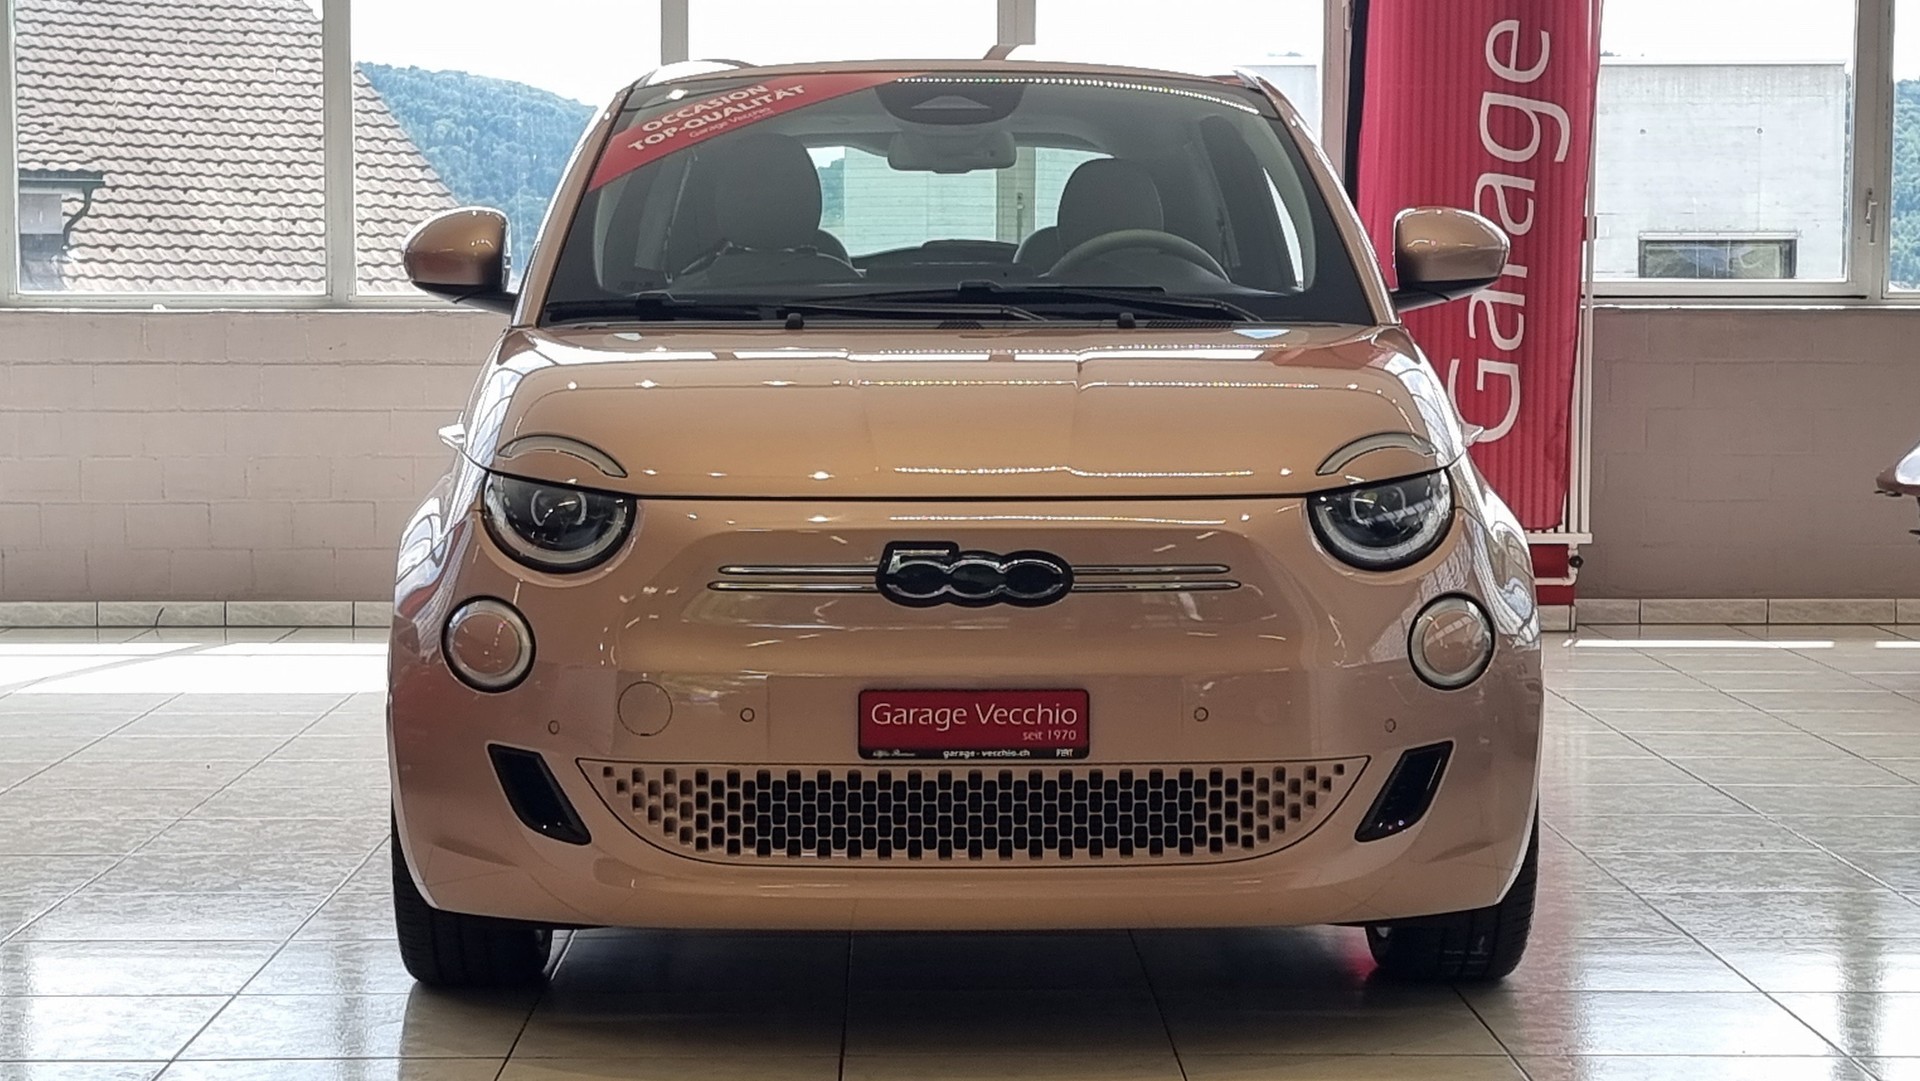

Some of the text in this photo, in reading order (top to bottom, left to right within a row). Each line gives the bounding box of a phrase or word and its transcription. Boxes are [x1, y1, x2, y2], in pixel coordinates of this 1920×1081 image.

[628, 84, 806, 151] TOP-QUALITÄT
[642, 84, 769, 132] OCCASION
[689, 121, 728, 138] Garage
[1447, 19, 1571, 444] Gaage
[884, 549, 1064, 599] 500
[871, 703, 1078, 732] Garage Vecchio
[1022, 729, 1077, 741] seit 1970
